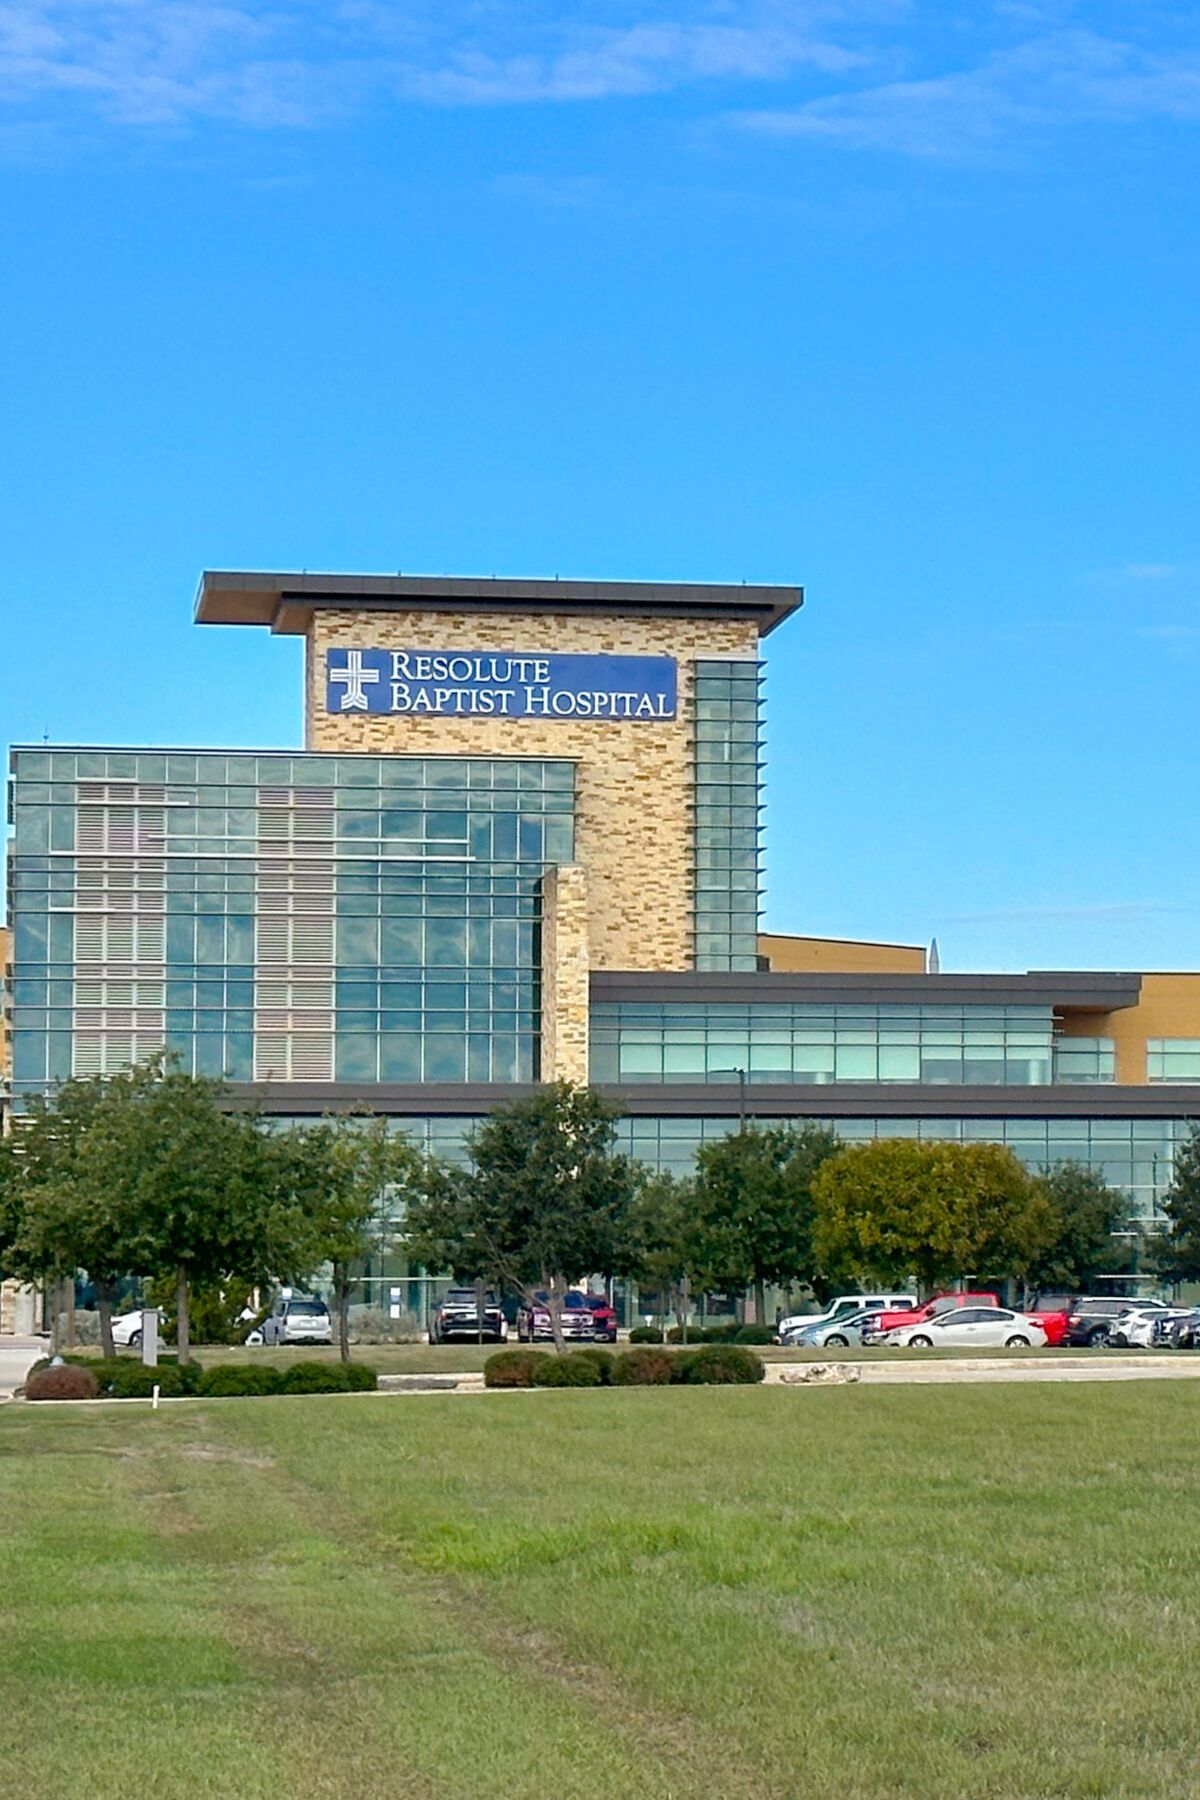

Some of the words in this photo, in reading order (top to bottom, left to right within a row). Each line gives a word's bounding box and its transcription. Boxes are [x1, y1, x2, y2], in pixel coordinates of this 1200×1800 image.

[390, 652, 550, 682] RESOLUTE
[390, 683, 514, 713] BAPTIST
[524, 686, 673, 716] HOSPITAL
